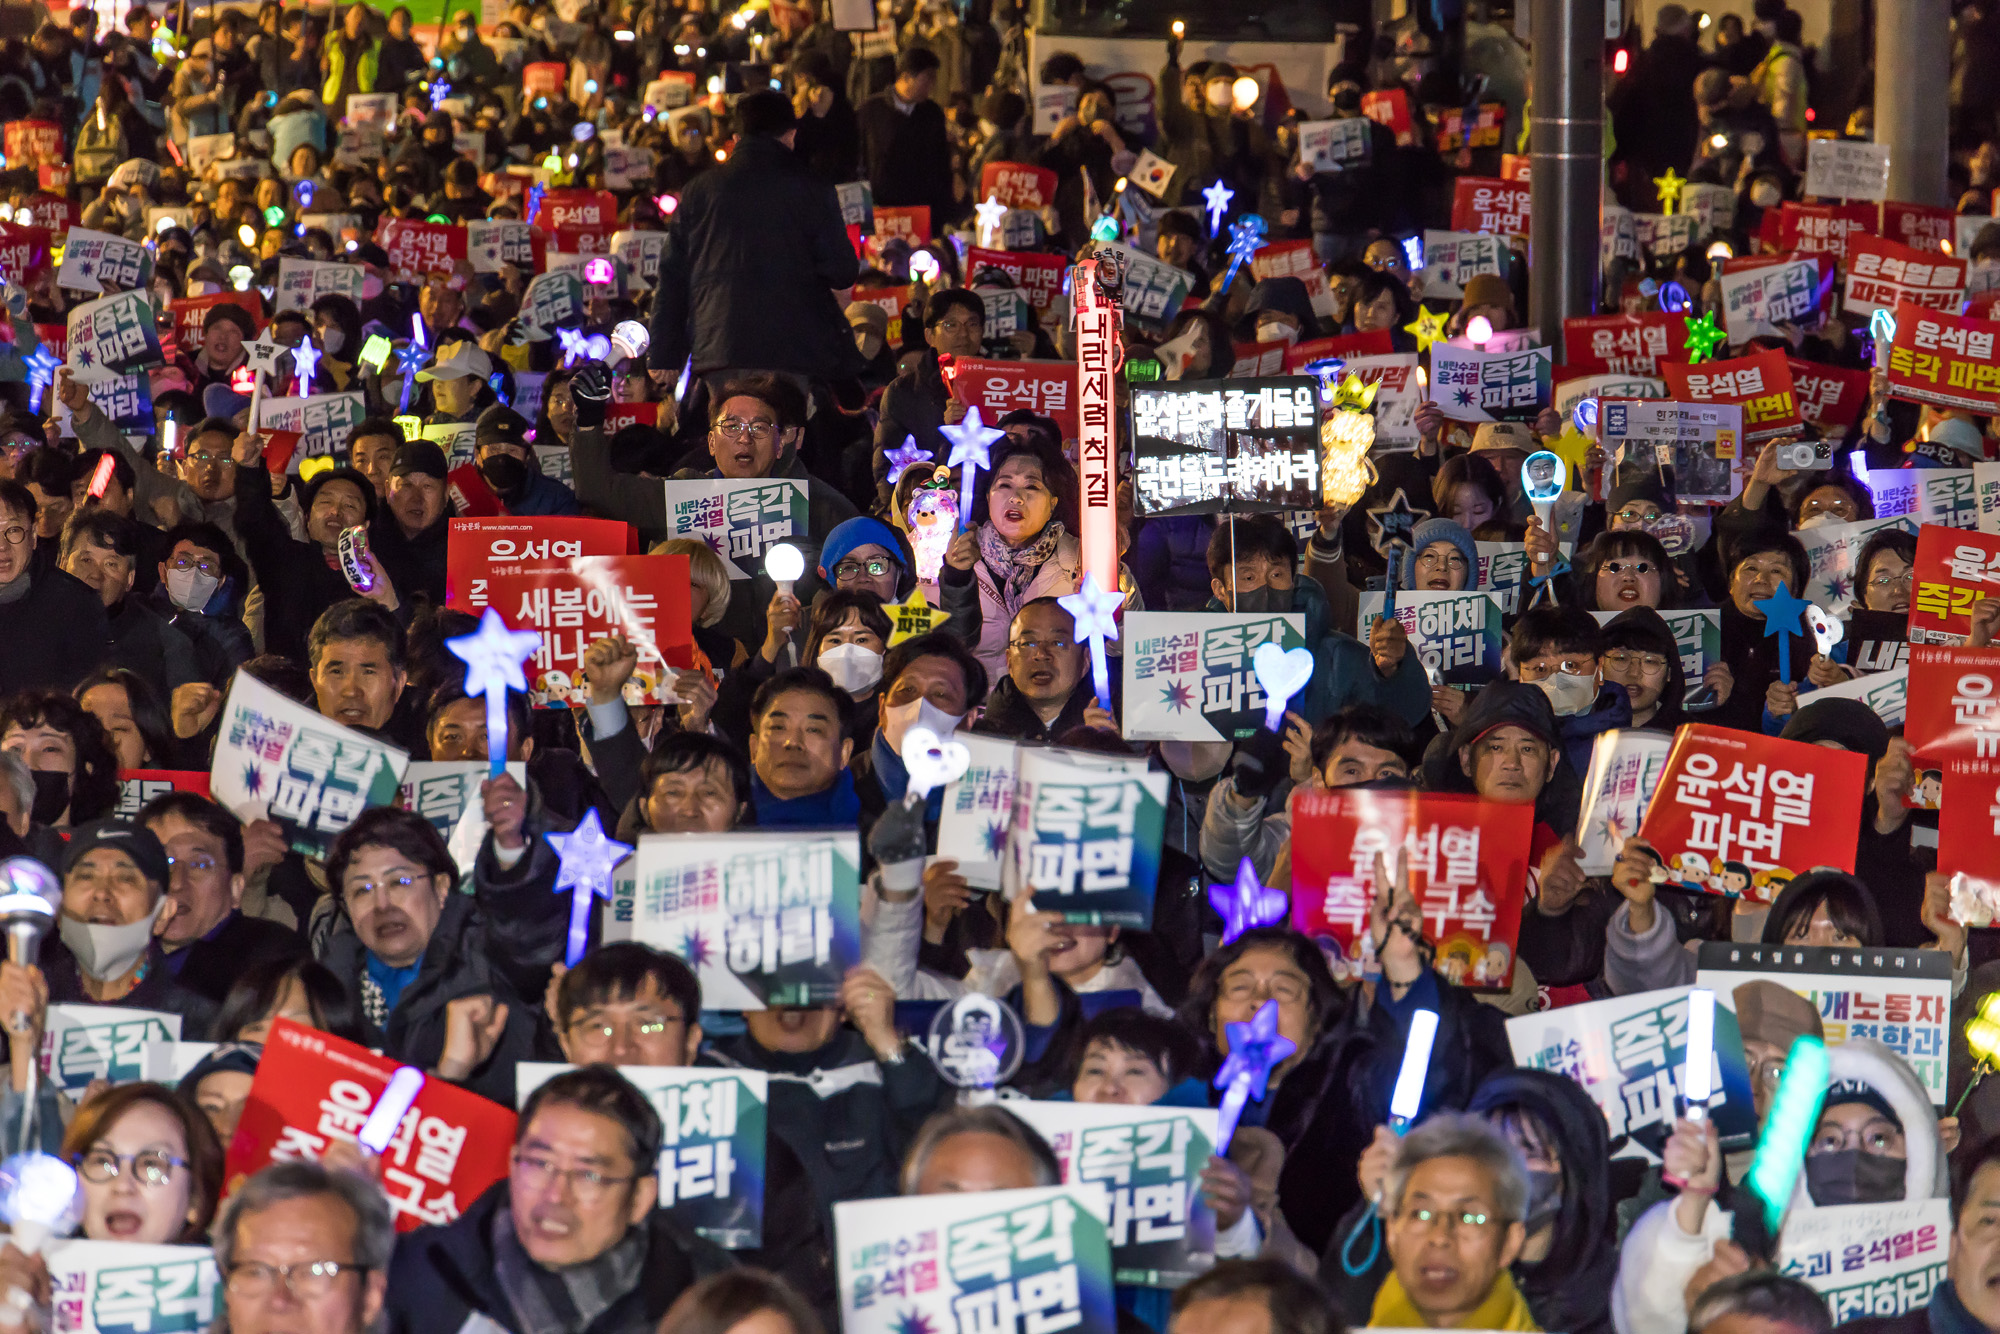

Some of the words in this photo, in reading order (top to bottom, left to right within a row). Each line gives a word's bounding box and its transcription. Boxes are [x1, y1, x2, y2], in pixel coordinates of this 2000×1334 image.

[551, 205, 601, 225] 윤석열
[1473, 188, 1530, 216] 윤석열
[400, 228, 449, 254] 윤석열
[1480, 212, 1522, 236] 파면
[1797, 237, 1848, 259] 새나라
[1024, 266, 1059, 291] 파면
[1854, 252, 1962, 289] 윤석열을
[96, 298, 139, 340] 즉각
[1769, 289, 1811, 322] 파면
[98, 325, 147, 364] 파면
[1592, 324, 1668, 359] 윤석열
[1914, 319, 1995, 360] 윤석열
[1438, 359, 1481, 375] 내란수괴
[1438, 370, 1481, 386] 윤석열
[1482, 352, 1539, 384] 즉각
[1686, 366, 1765, 400] 윤석열
[1890, 346, 1943, 384] 즉각
[1947, 360, 2000, 394] 파면
[983, 377, 1067, 412] 윤석열
[1481, 380, 1537, 412] 파면
[304, 397, 353, 434] 즉각
[305, 424, 349, 456] 파면
[674, 494, 724, 517] 내란수괴
[728, 484, 794, 525] 즉각
[1927, 474, 1976, 513] 즉각
[454, 522, 480, 532] 나눔문화
[482, 523, 533, 533] www.nanum.com
[675, 508, 725, 533] 윤석열
[729, 519, 791, 564] 파면
[515, 585, 659, 628] 새봄에는
[1420, 594, 1487, 638] 해체
[896, 616, 932, 635] 파면
[1133, 631, 1199, 658] 내란수괴
[1204, 621, 1289, 670] 즉각
[1421, 637, 1487, 672] 하라
[1134, 647, 1199, 681] 윤석열
[1677, 752, 1815, 827] 윤석열
[1035, 782, 1141, 839] 즉각
[1685, 810, 1785, 873] 파면
[1031, 836, 1136, 894] 파면
[1422, 872, 1497, 939] 구속
[724, 903, 836, 975] 하라
[1730, 949, 1804, 966] 윤석열을
[1830, 954, 1921, 970] 탄핵하라!
[1081, 1119, 1194, 1185] 즉각
[852, 1229, 940, 1270] 내란수괴
[949, 1197, 1077, 1283] 즉각
[1841, 1224, 1939, 1275] 윤석열은
[97, 1258, 220, 1334] 즉각
[852, 1256, 940, 1311] 윤석열
[953, 1260, 1082, 1334] 파면
